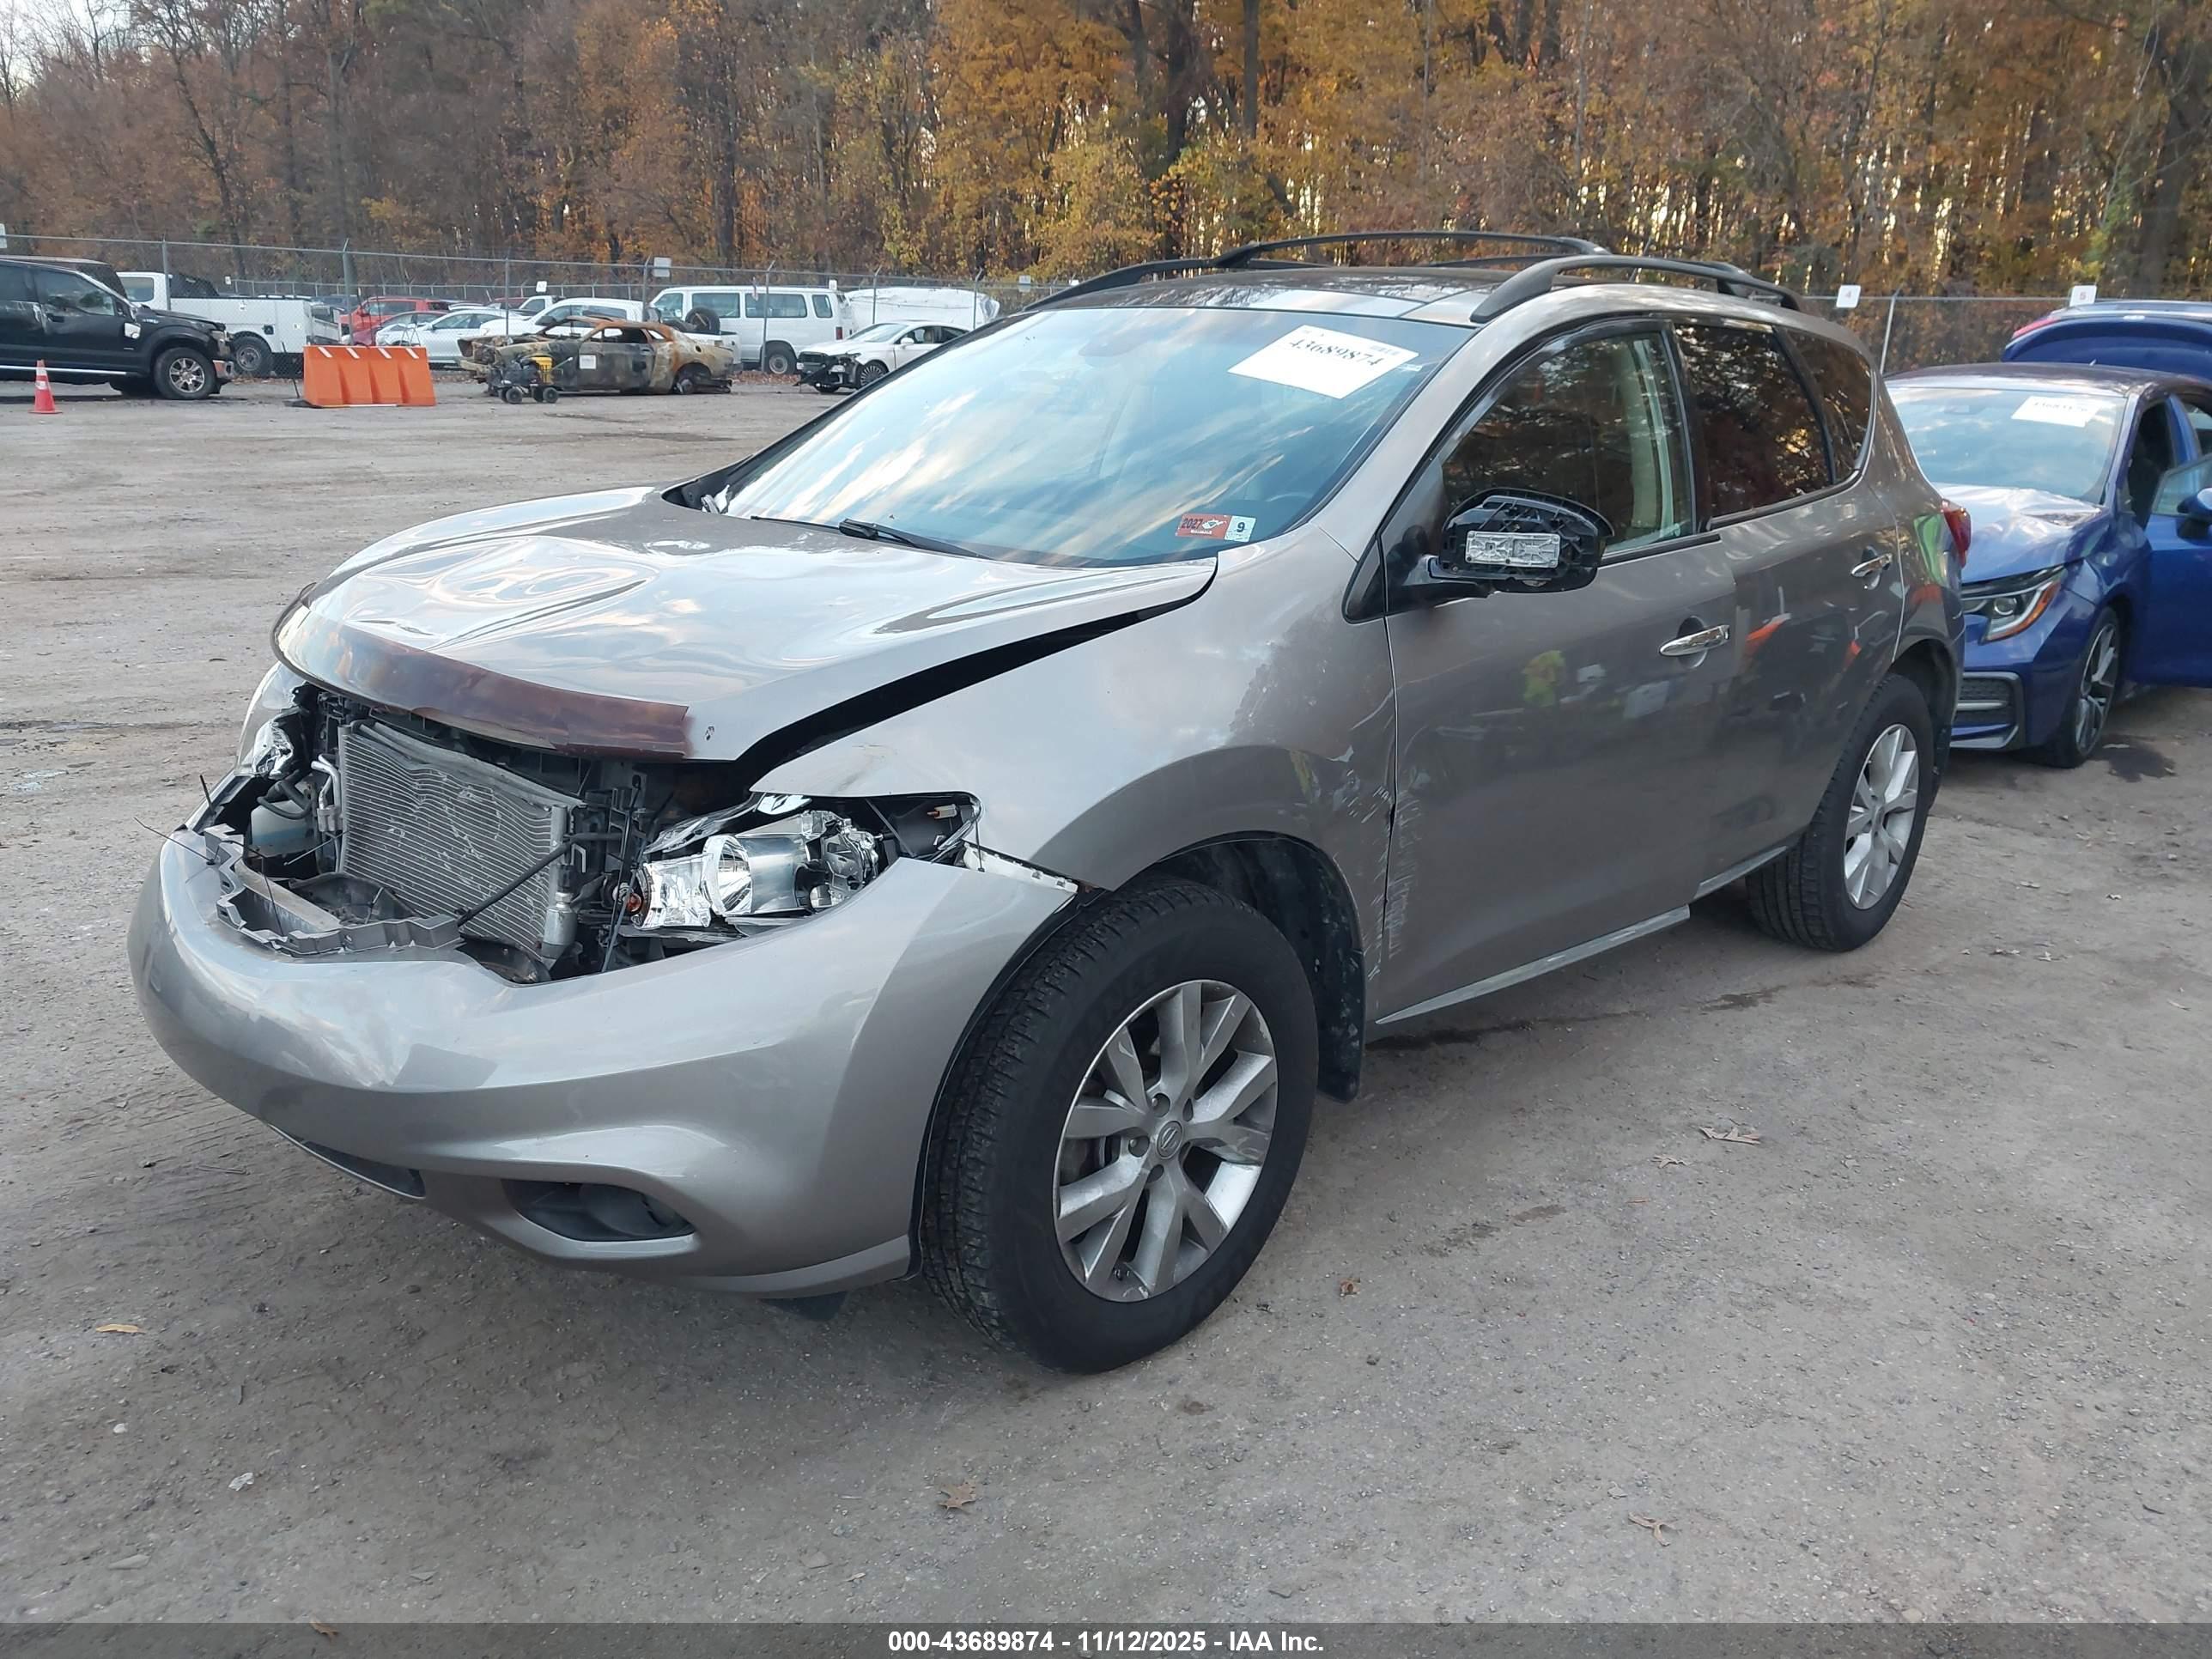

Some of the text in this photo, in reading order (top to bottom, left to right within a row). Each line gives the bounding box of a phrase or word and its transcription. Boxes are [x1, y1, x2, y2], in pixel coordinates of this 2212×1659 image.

[1844, 290, 1852, 299] 4
[1289, 338, 1384, 366] 43689874
[1181, 518, 1204, 530] 2027
[1236, 521, 1246, 533] 9
